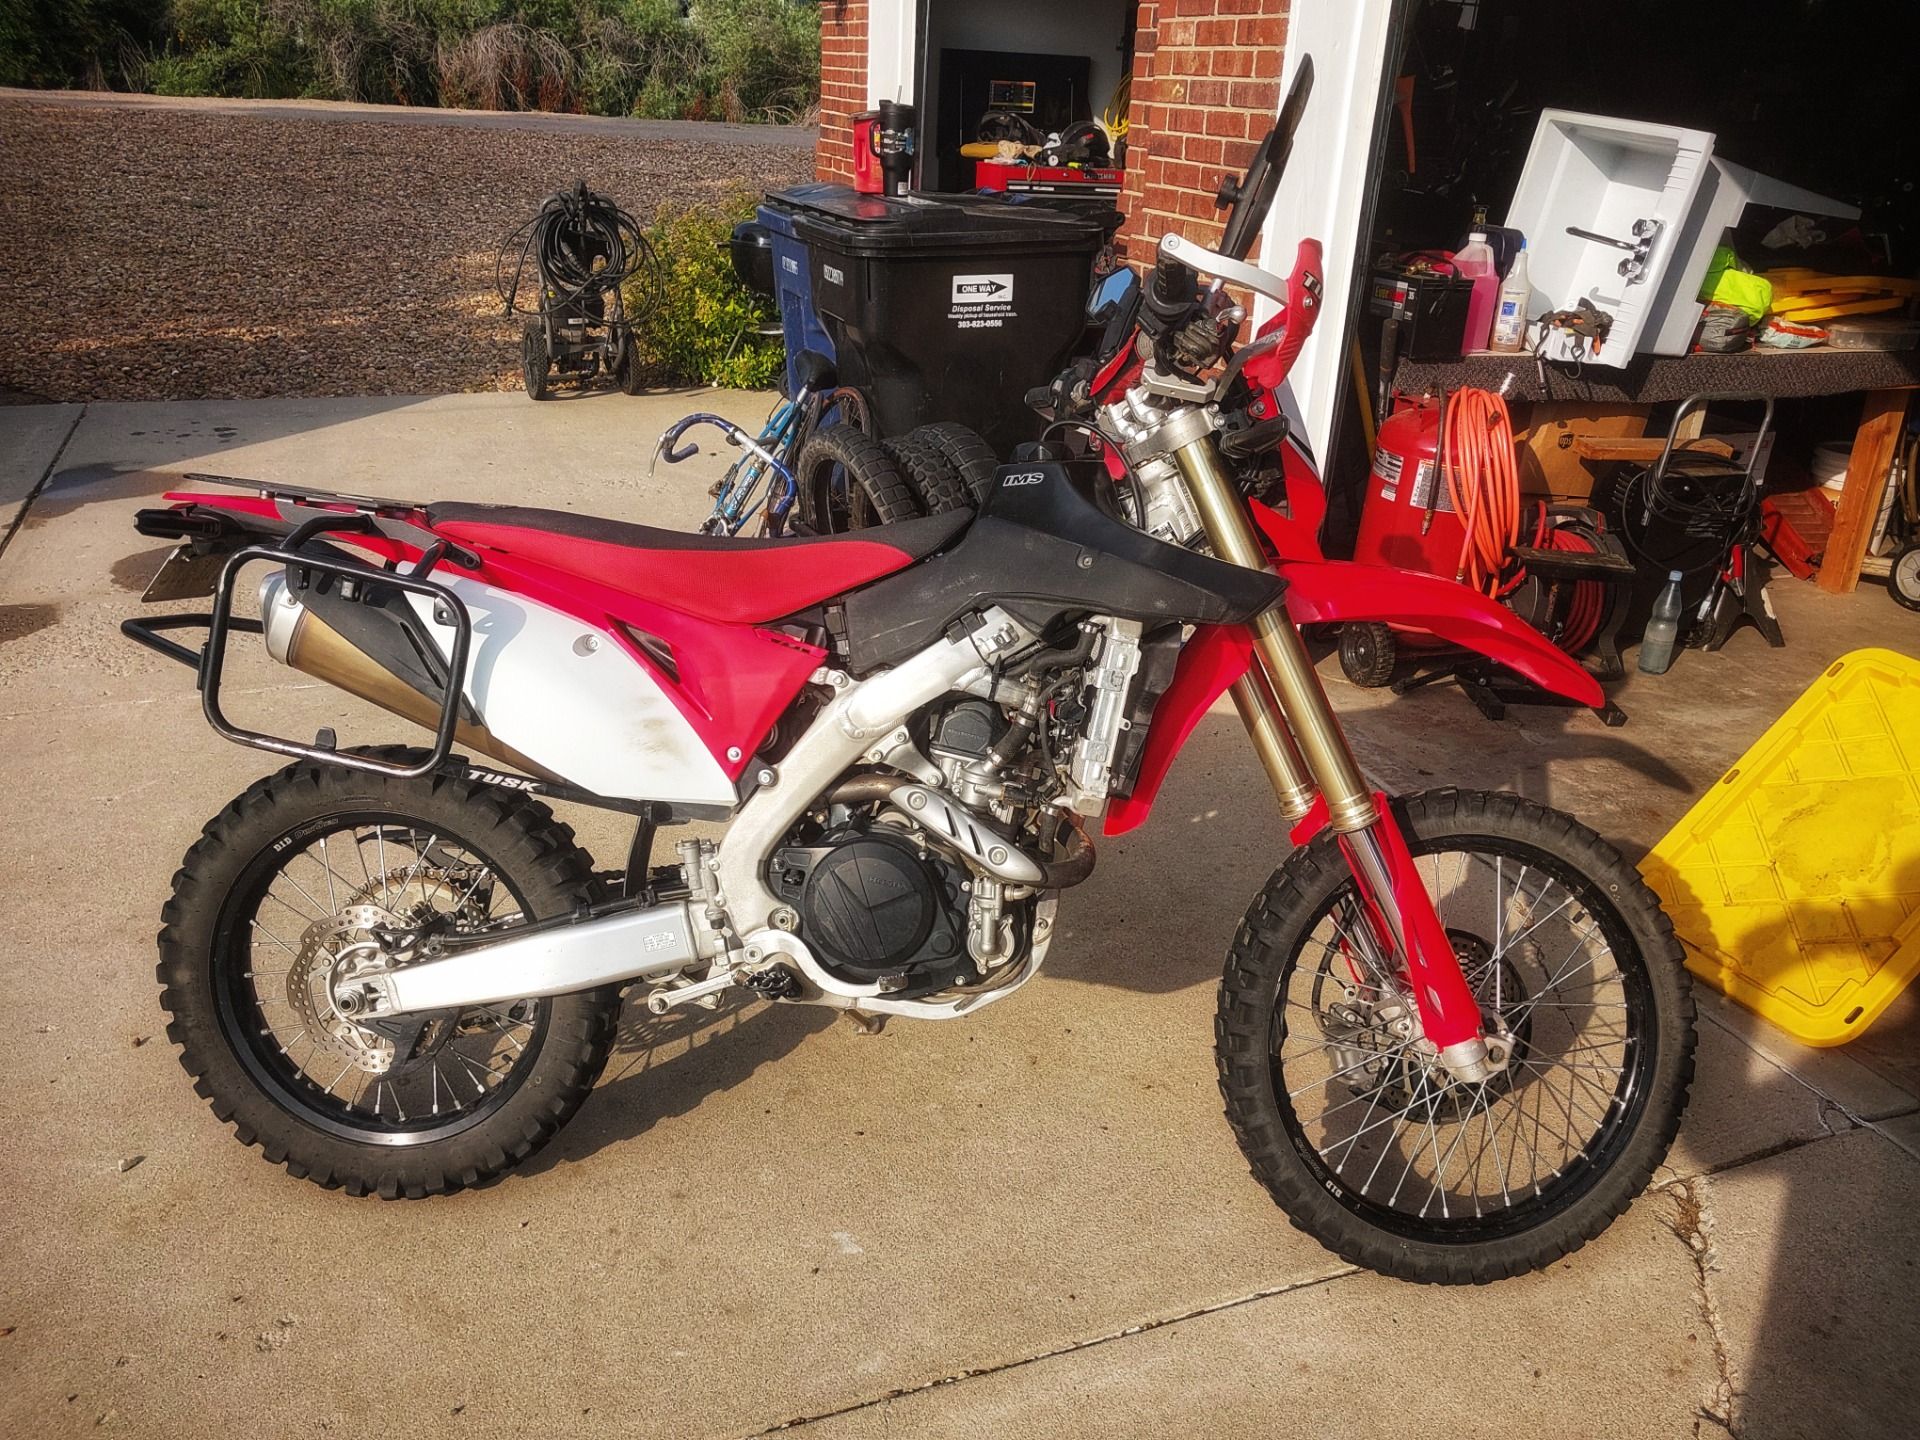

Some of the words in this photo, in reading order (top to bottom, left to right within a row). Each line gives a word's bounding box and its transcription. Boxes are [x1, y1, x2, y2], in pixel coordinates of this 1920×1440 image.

[961, 285, 978, 293] ONE
[979, 284, 997, 293] WAY
[952, 304, 984, 313] Disposal
[984, 304, 1012, 312] Service
[1003, 472, 1044, 487] IMS
[468, 769, 542, 792] TUSK
